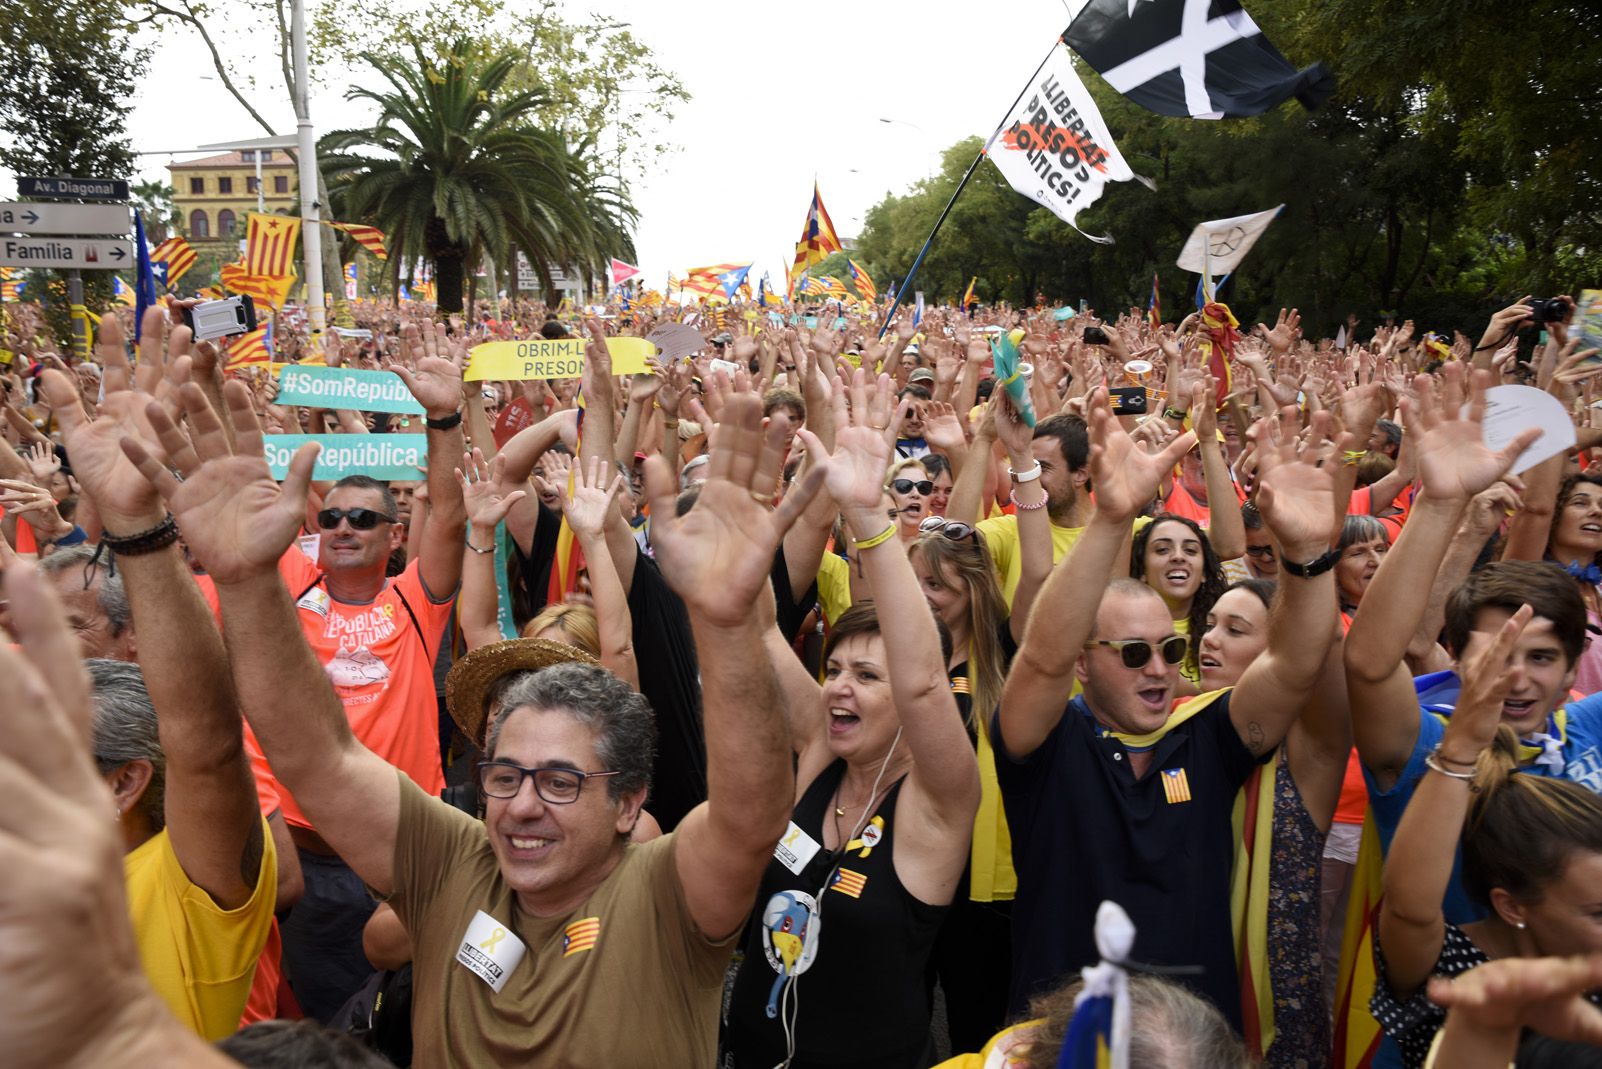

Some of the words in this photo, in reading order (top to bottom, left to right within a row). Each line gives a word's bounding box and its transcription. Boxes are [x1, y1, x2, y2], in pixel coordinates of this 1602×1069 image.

[34, 180, 55, 192] Av.
[58, 181, 115, 195] Diagonal
[6, 242, 73, 260] Família
